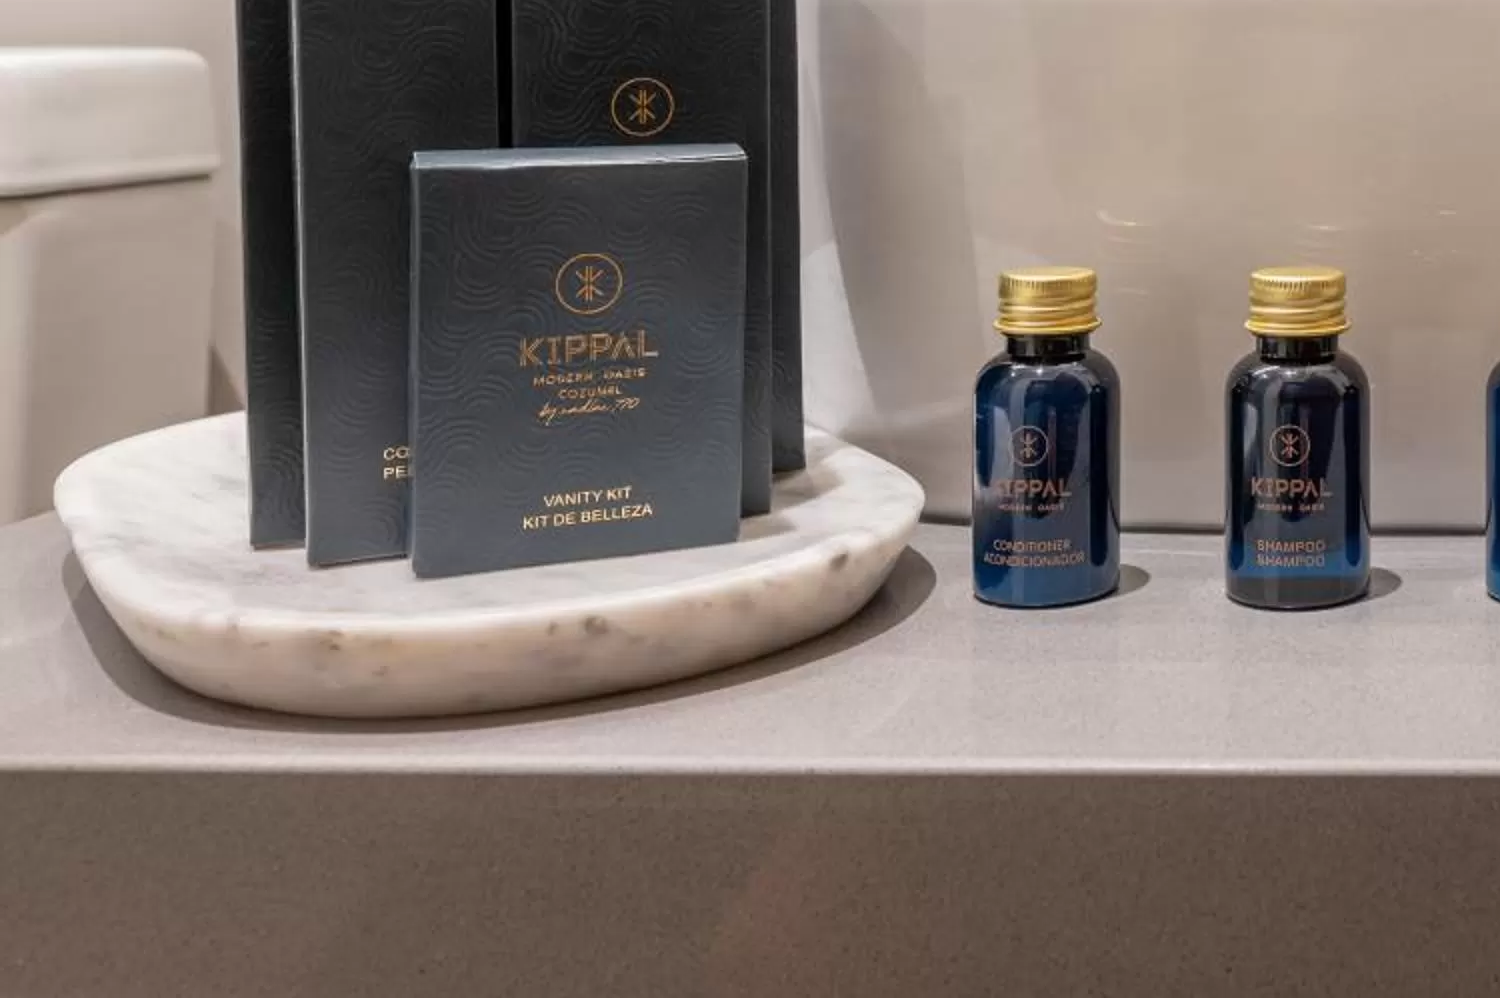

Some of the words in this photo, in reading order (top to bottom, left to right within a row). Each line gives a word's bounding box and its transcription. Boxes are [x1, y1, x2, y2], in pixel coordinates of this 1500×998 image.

[519, 329, 660, 367] KIPPAL
[533, 371, 593, 387] MODERN
[558, 384, 623, 399] COZUMEL
[383, 446, 409, 461] CO
[383, 465, 408, 480] PE
[1251, 477, 1334, 498] KIPPAL
[543, 489, 603, 508] VANITY
[606, 485, 633, 501] KIT
[522, 515, 551, 531] KIT
[553, 512, 577, 527] DE
[580, 503, 653, 523] BELLEZA
[992, 538, 1072, 552] CONDITIONER
[1256, 539, 1326, 553] SHAMPOO
[1256, 553, 1325, 568] SHAMPOO
